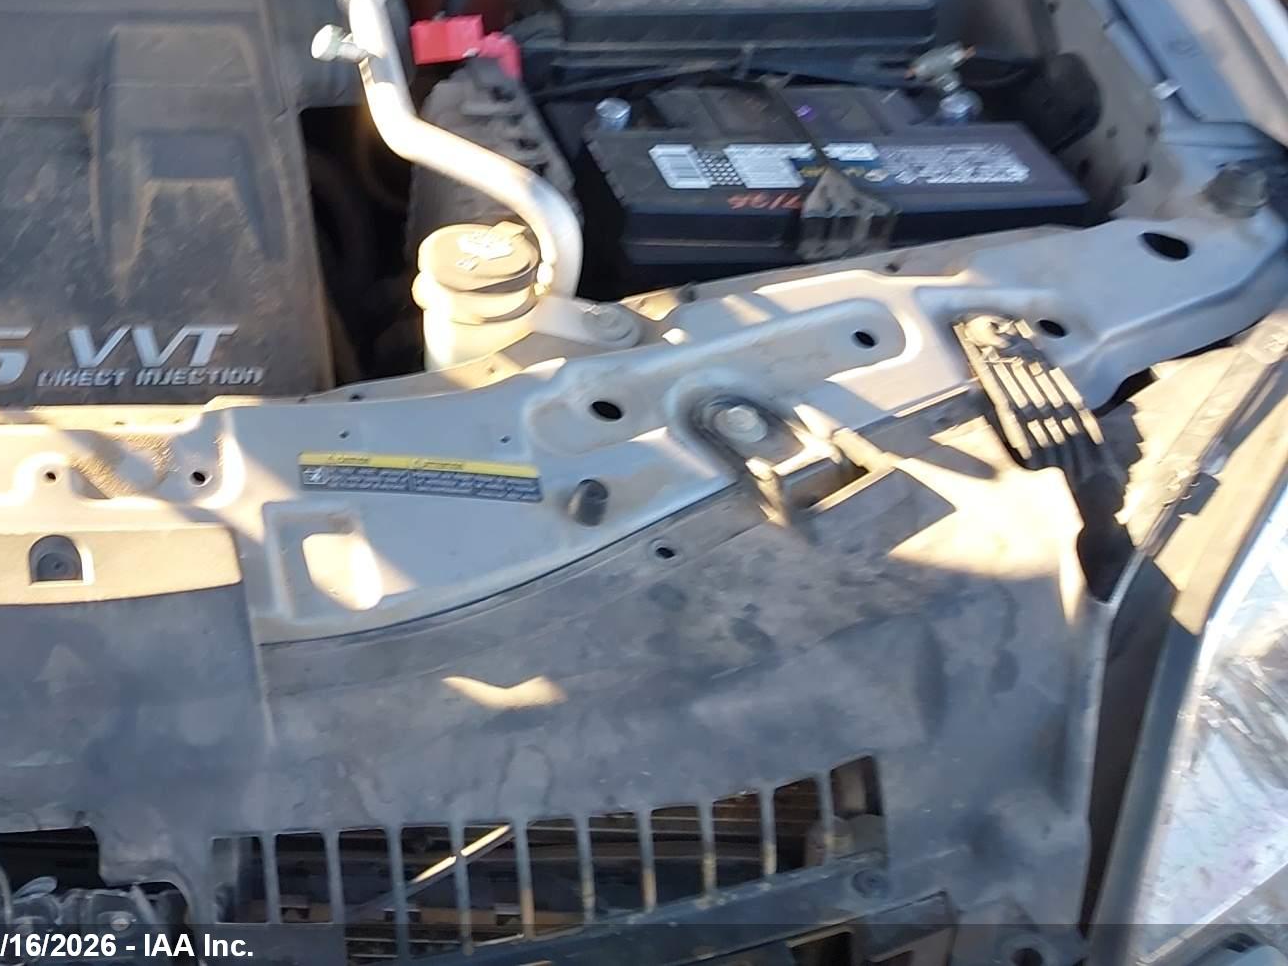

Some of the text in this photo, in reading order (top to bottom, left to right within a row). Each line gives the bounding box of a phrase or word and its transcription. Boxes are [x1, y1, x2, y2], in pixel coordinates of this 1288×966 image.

[67, 324, 239, 368] VVT
[36, 367, 266, 388] DIRECT INJECTION
